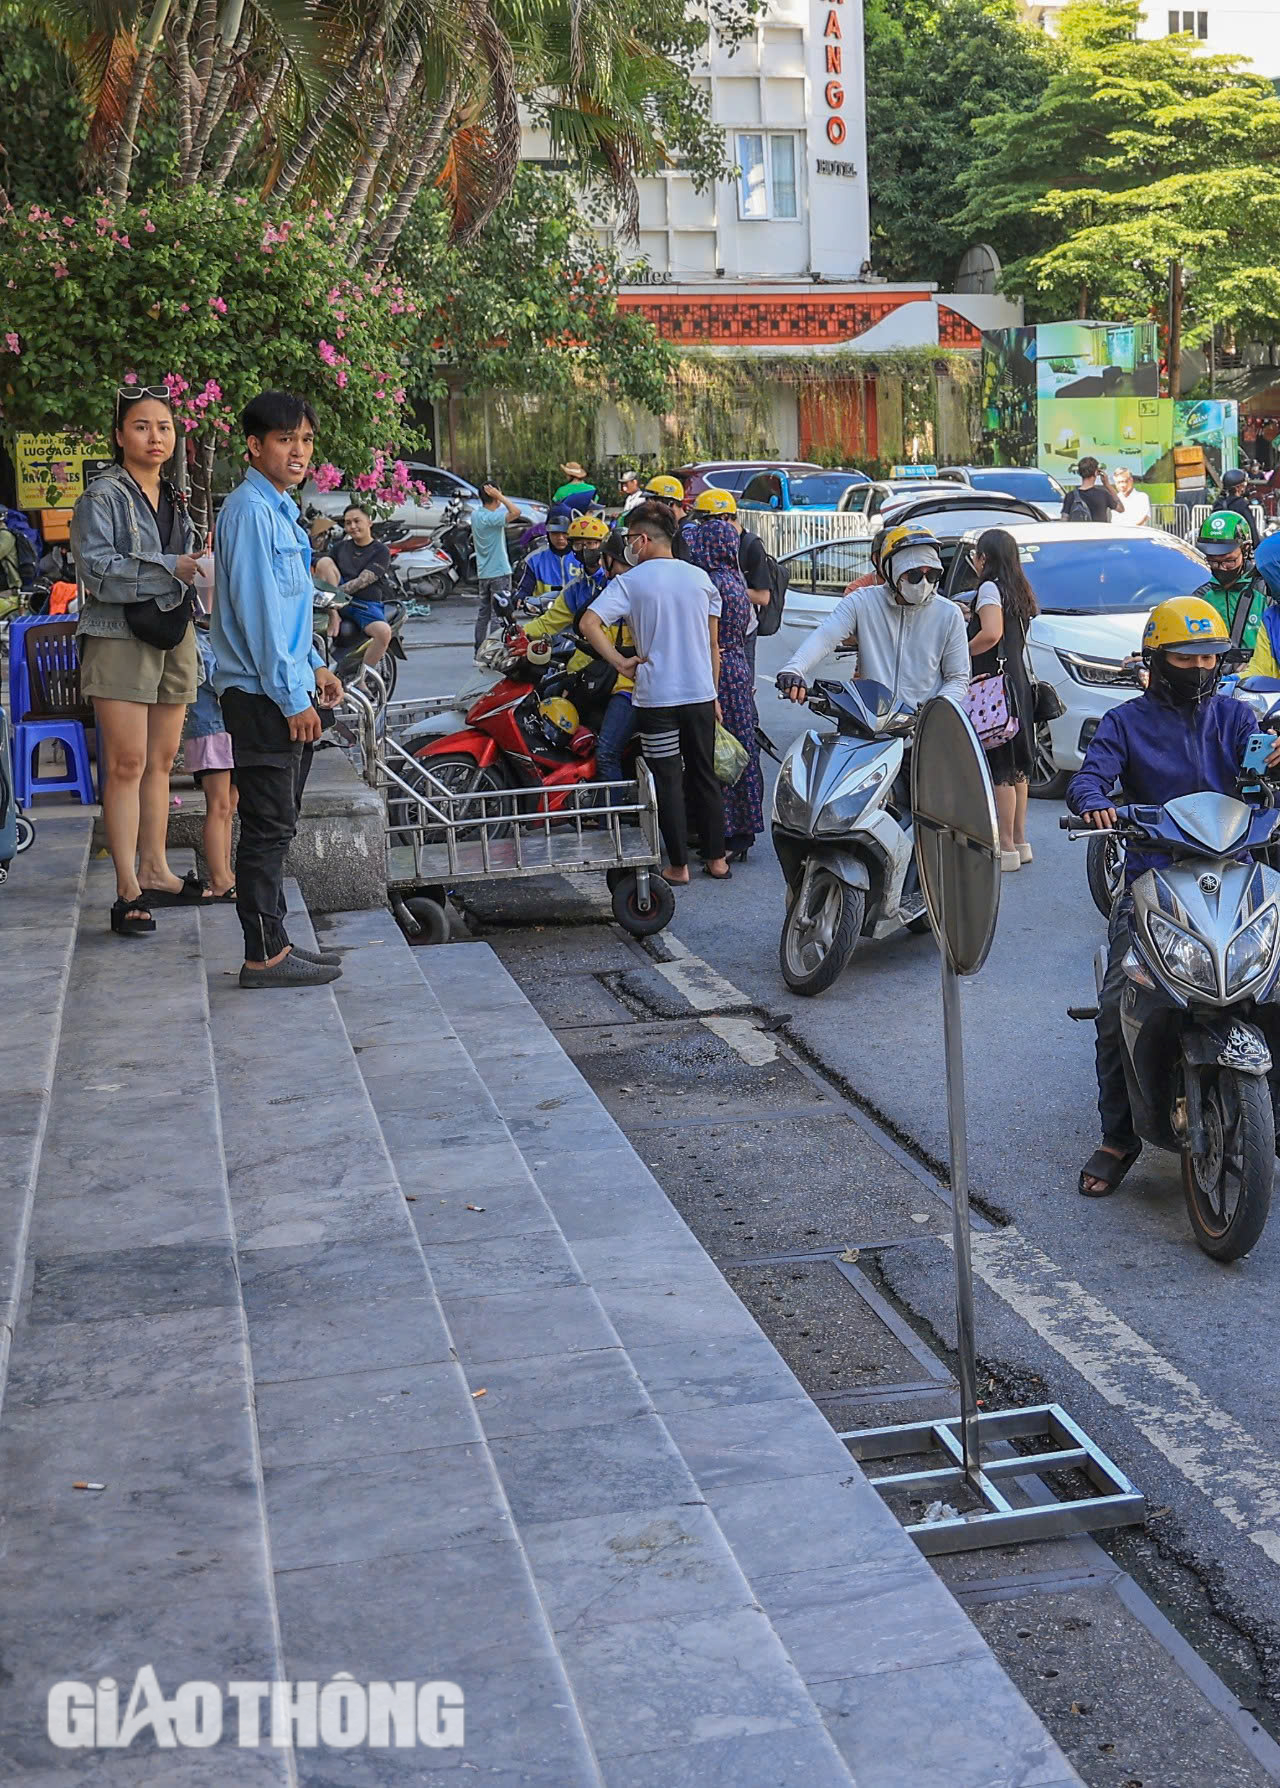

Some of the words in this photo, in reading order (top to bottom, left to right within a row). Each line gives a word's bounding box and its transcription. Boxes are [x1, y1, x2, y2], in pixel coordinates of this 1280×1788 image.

[818, 0, 846, 145] ANGO
[816, 158, 858, 178] HOTEL
[24, 446, 77, 456] LUGGAGE
[1184, 615, 1213, 634] be
